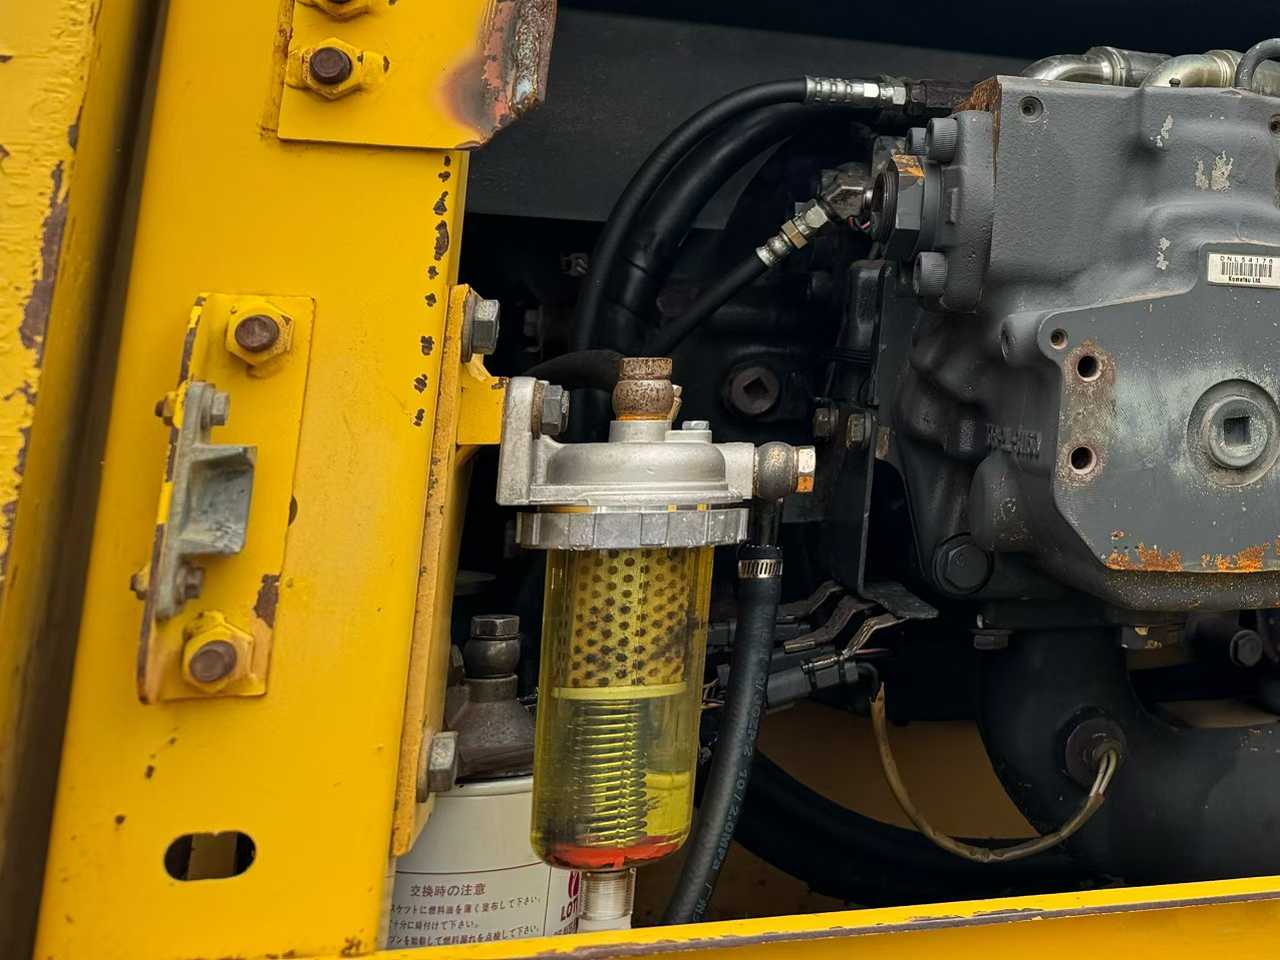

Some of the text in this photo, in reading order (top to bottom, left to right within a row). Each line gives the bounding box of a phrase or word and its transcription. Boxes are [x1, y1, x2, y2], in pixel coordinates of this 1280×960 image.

[1228, 275, 1252, 283] Komatsu
[410, 883, 487, 897] 交換時の注意
